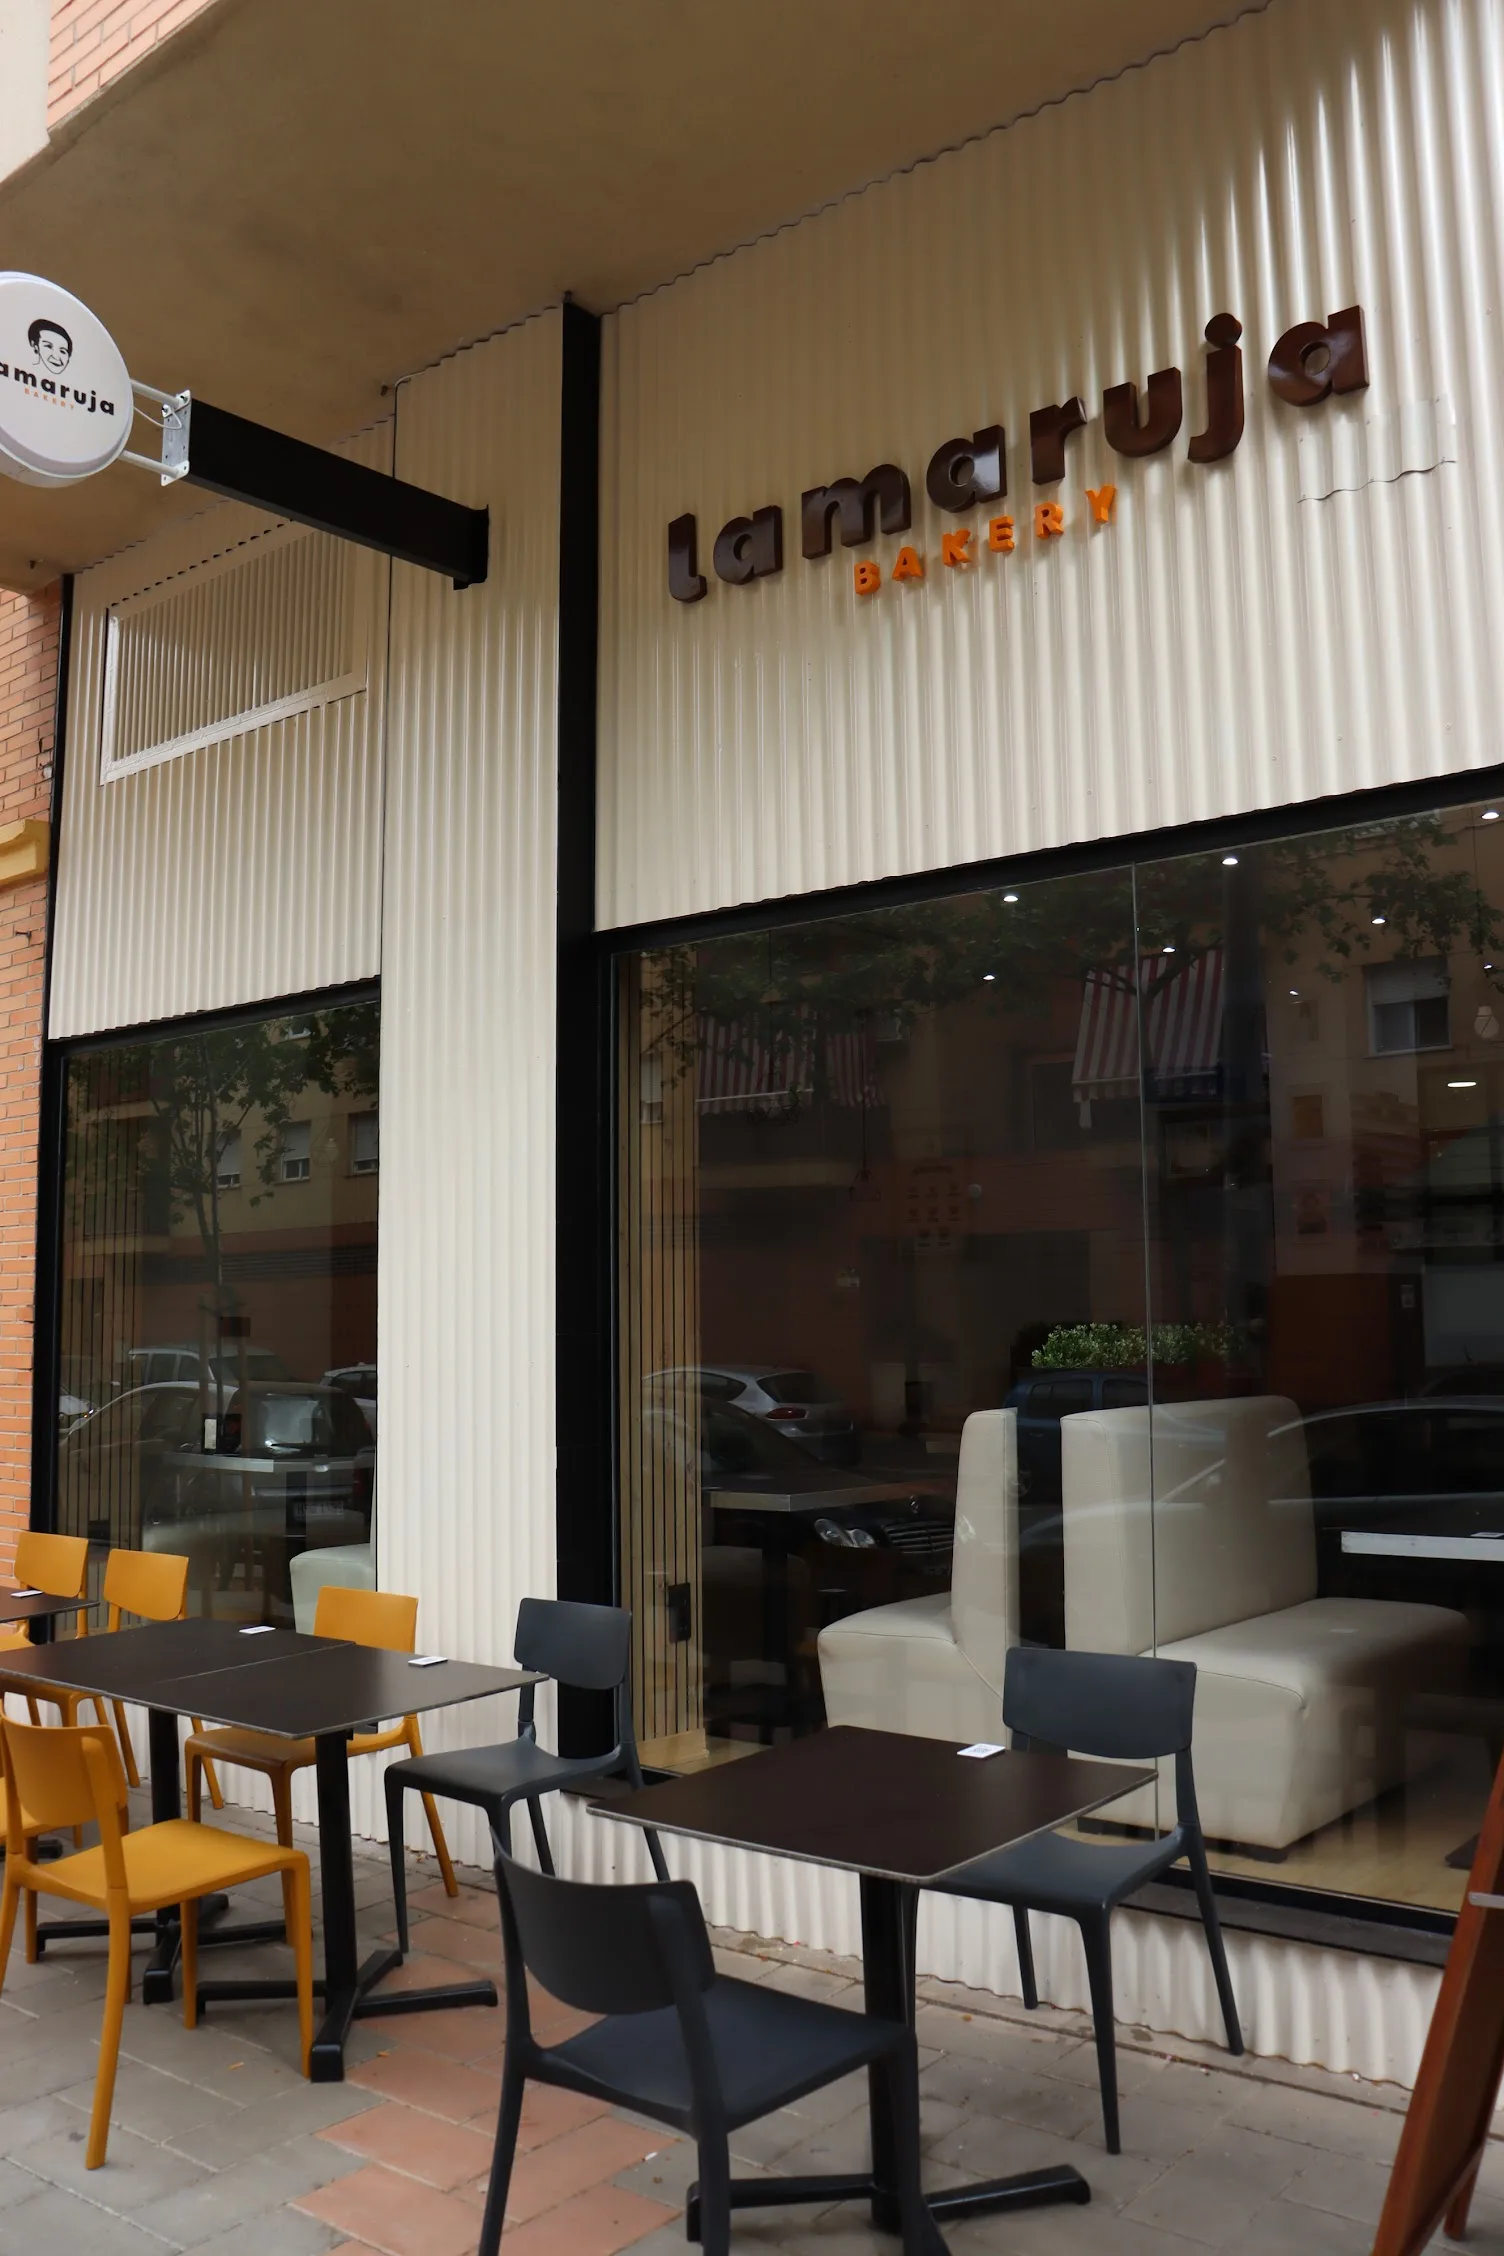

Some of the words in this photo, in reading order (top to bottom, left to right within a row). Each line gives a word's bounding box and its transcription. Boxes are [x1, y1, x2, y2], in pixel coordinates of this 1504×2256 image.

[24, 387, 75, 410] BAKERY
[668, 304, 1369, 603] lamaruja
[853, 484, 1117, 596] BAKERY
